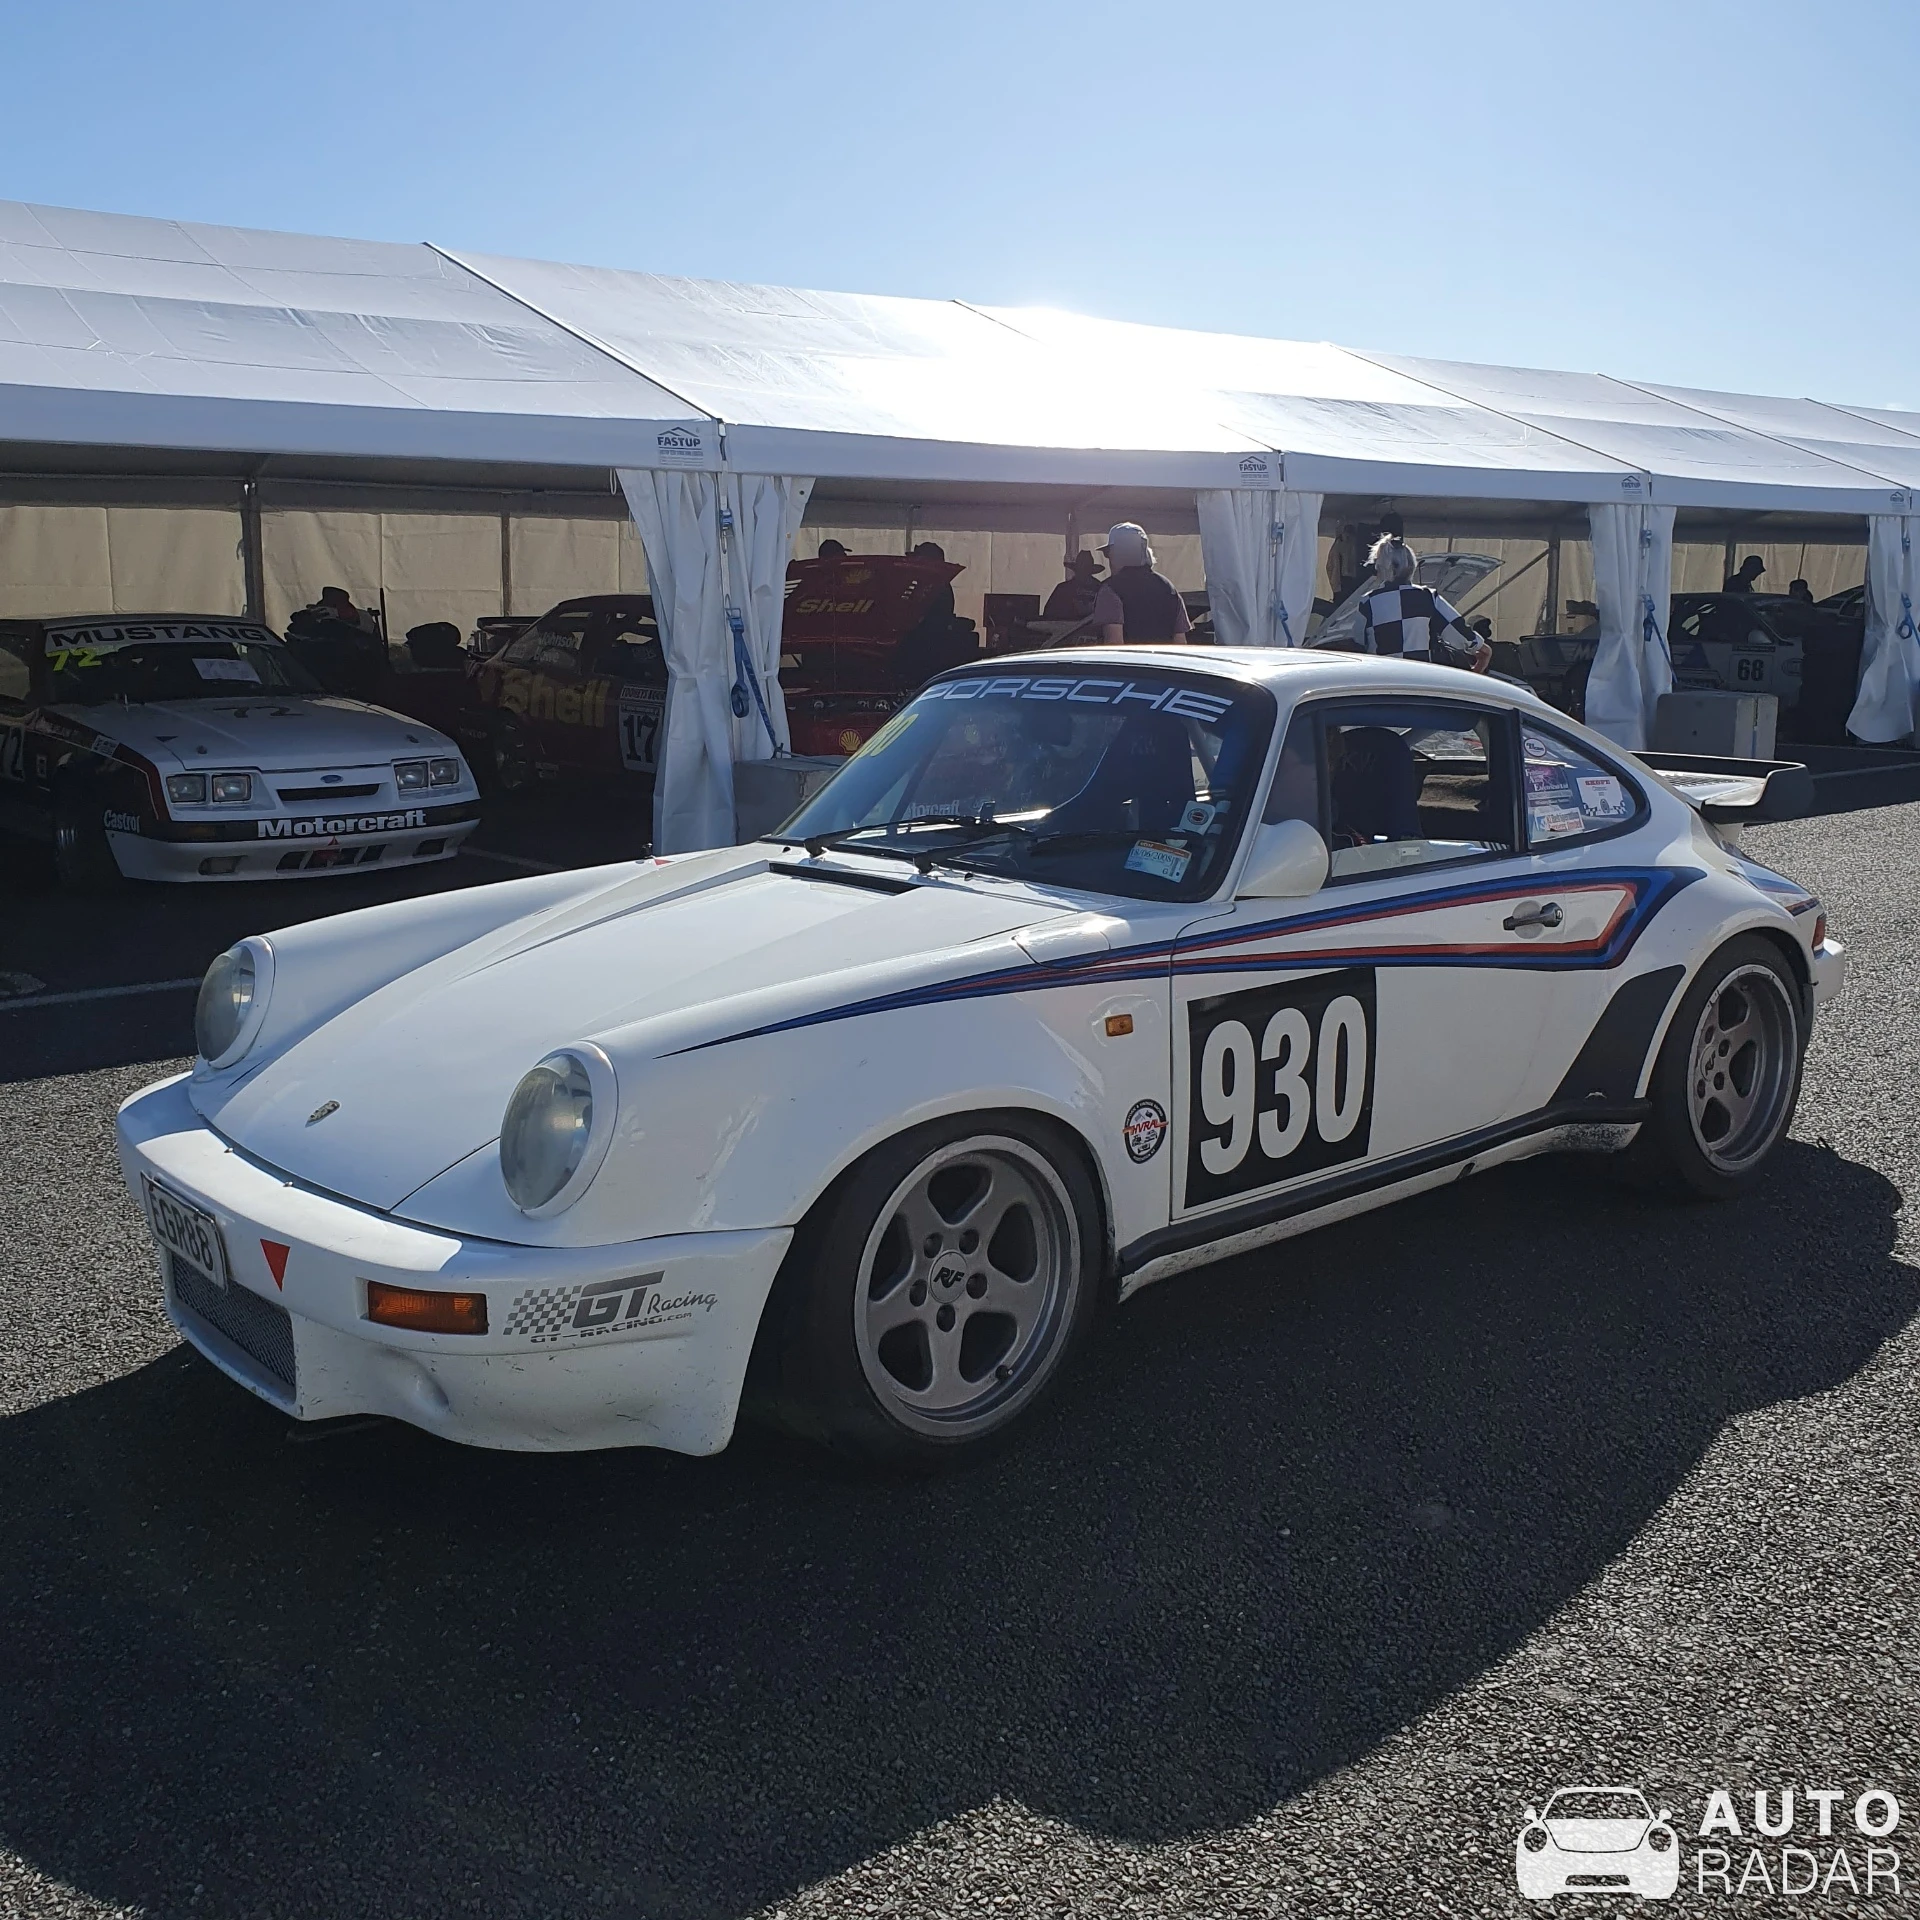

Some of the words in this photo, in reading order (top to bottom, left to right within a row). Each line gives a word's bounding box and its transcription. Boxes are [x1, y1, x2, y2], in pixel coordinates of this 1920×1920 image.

[657, 436, 701, 447] FASTUP
[1239, 463, 1267, 471] FASTUP
[796, 598, 875, 615] Shell
[51, 625, 268, 647] MUSTANG
[44, 648, 103, 672] 72
[1737, 658, 1764, 682] 68
[498, 666, 612, 729] Shell
[918, 678, 1234, 722] PORSCHE
[623, 713, 659, 763] 17
[103, 808, 140, 834] Castrol
[257, 809, 427, 839] Motorcraft
[1200, 995, 1367, 1175] 930
[149, 1188, 214, 1272] EGR88
[932, 1266, 965, 1289] RUF
[572, 1270, 666, 1329] GT
[647, 1290, 719, 1314] Racing
